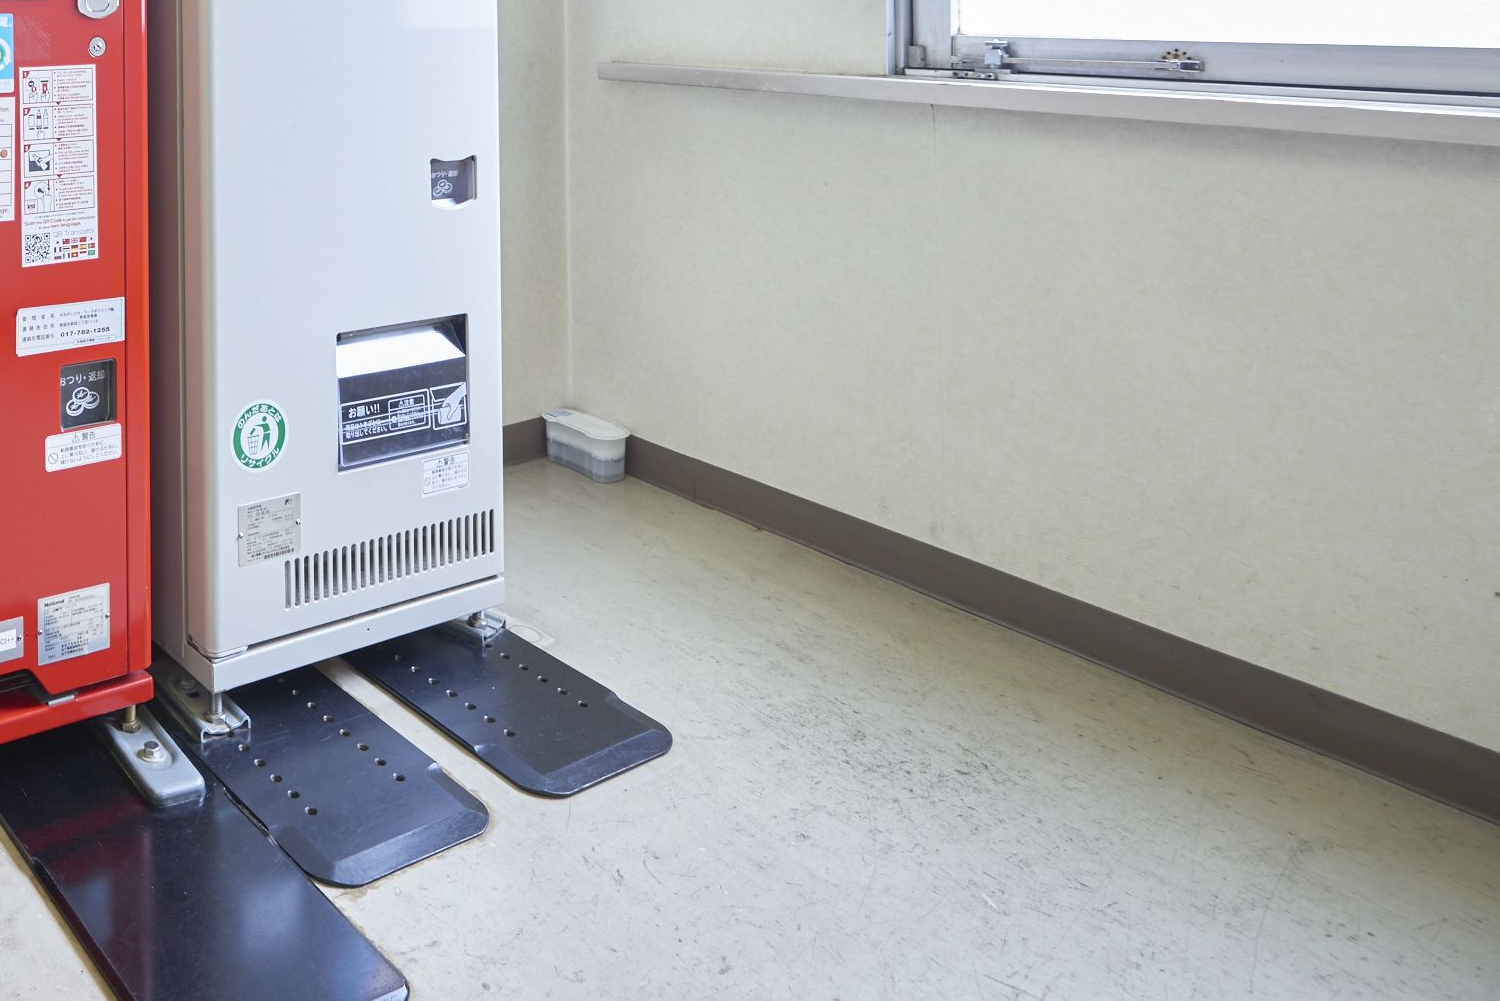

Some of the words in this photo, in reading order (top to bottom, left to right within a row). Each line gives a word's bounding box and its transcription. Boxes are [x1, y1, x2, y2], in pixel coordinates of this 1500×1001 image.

[237, 403, 284, 430] のんだあとは
[348, 403, 380, 419] お願い!!
[240, 446, 280, 468] リサイクル
